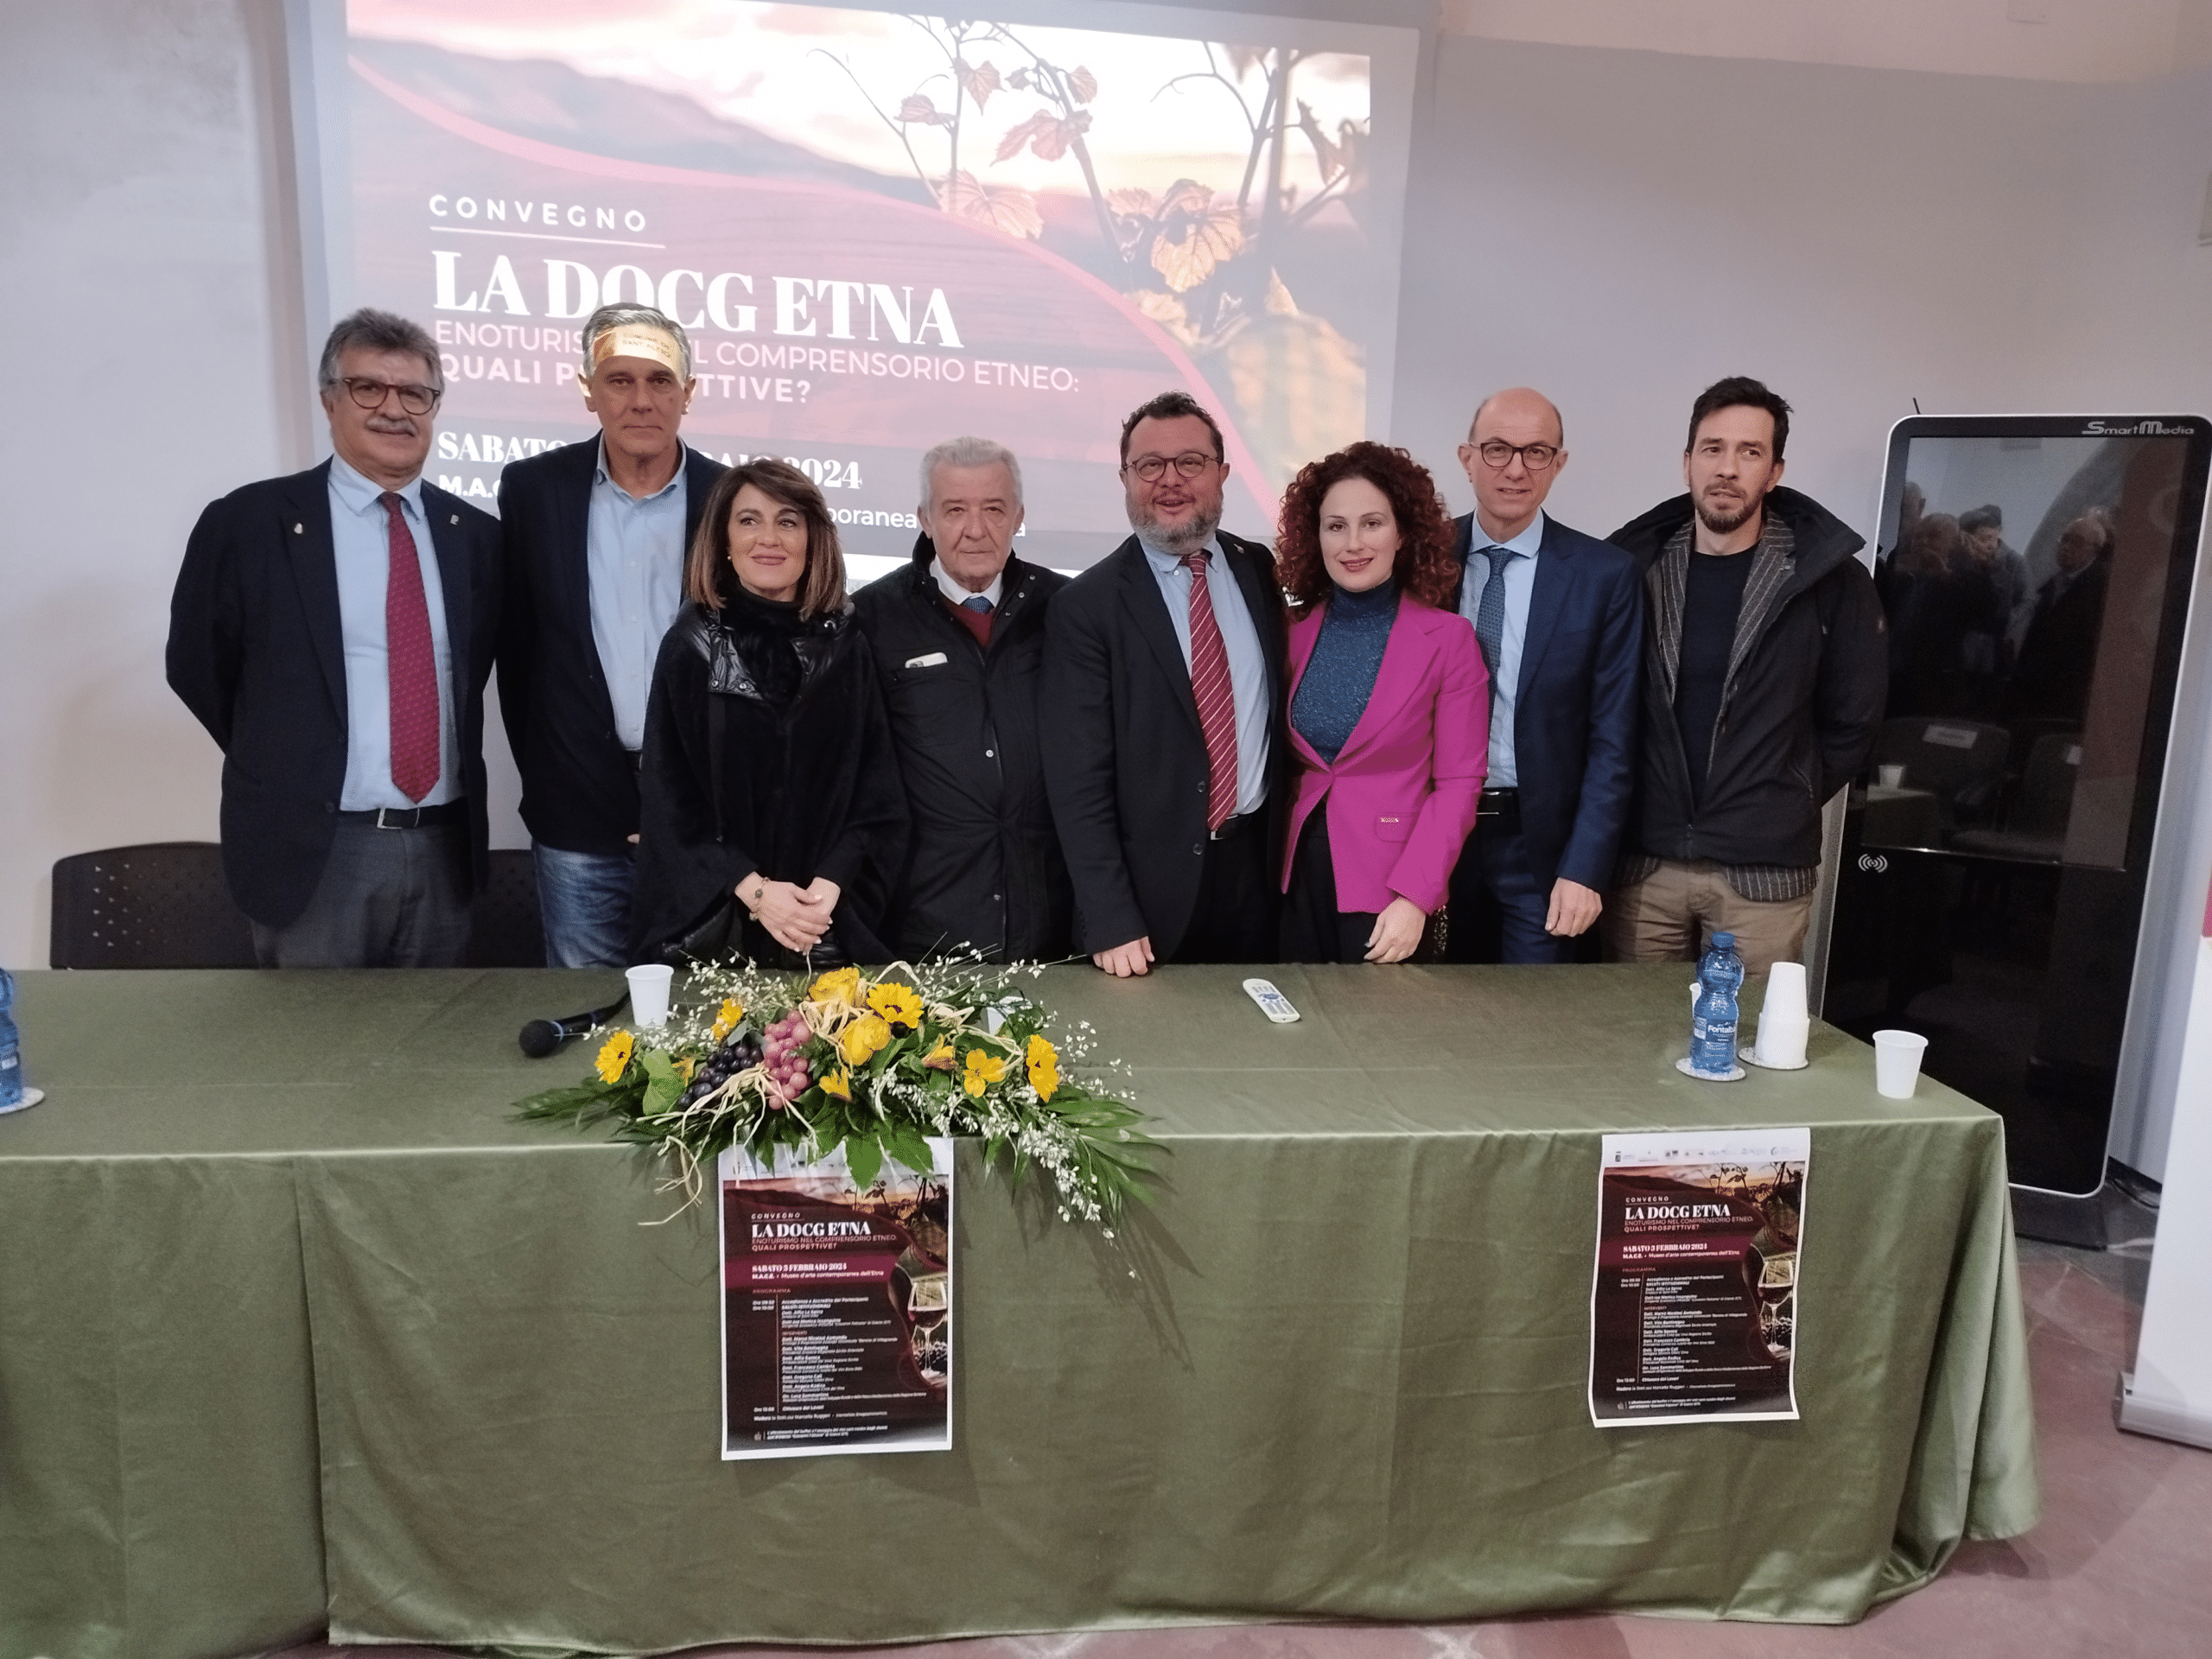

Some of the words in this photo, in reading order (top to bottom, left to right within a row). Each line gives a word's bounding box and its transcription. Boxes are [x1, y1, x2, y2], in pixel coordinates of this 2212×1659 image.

[429, 194, 646, 232] CONVEGNO
[432, 250, 531, 316] LA
[543, 258, 758, 333] DOCG
[772, 276, 965, 348] ETNA
[440, 353, 541, 384] QUALI
[715, 341, 965, 383] COMPRENSORIO
[975, 359, 1079, 392] ETNEO:
[2082, 421, 2195, 435] SmartMedia
[438, 431, 568, 464] SABAT
[1625, 1207, 1644, 1220] LA
[1647, 1205, 1690, 1219] DOCG
[1692, 1204, 1731, 1217] ETNA
[752, 1224, 774, 1237] LA
[777, 1223, 825, 1236] DOCG
[828, 1221, 871, 1236] ETNA
[1623, 1244, 1650, 1253] SABATO
[752, 1264, 783, 1273] SABATO
[789, 1263, 829, 1272] FEBBRAIO
